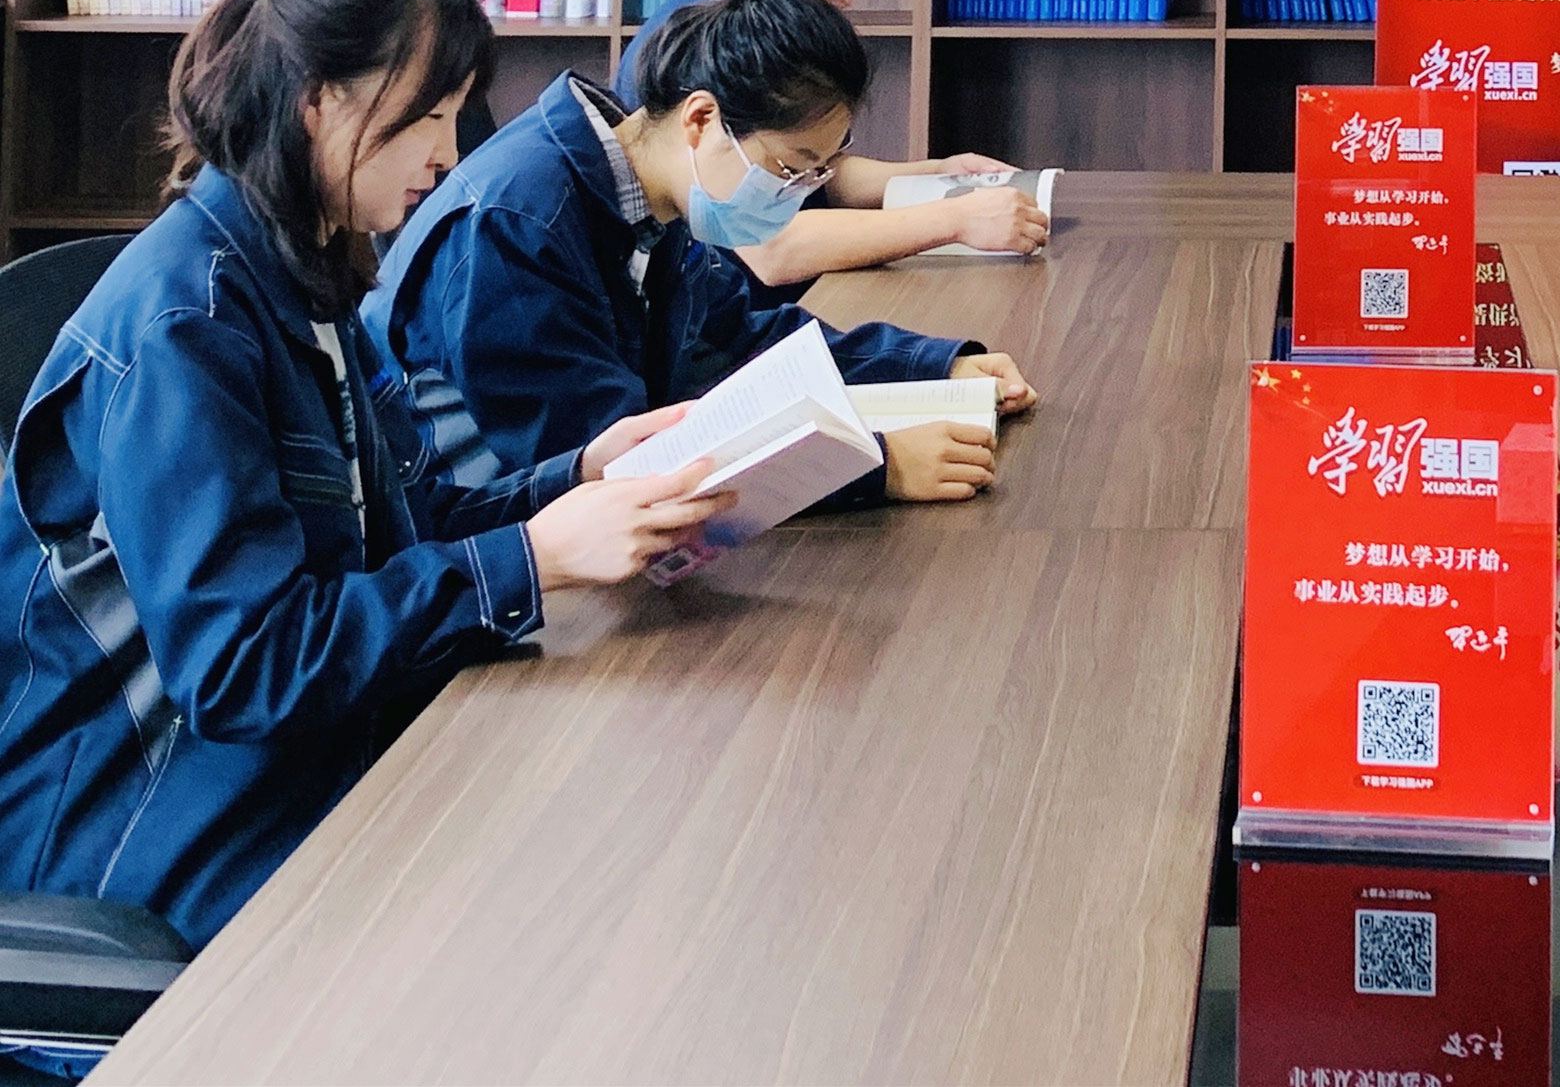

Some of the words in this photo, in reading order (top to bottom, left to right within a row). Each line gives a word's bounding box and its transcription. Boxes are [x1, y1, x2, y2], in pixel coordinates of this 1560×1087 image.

[1484, 88, 1538, 102] xuexi.cn
[1421, 479, 1499, 497] xuexi.cn
[1293, 579, 1460, 609] 事业从实践起步。
